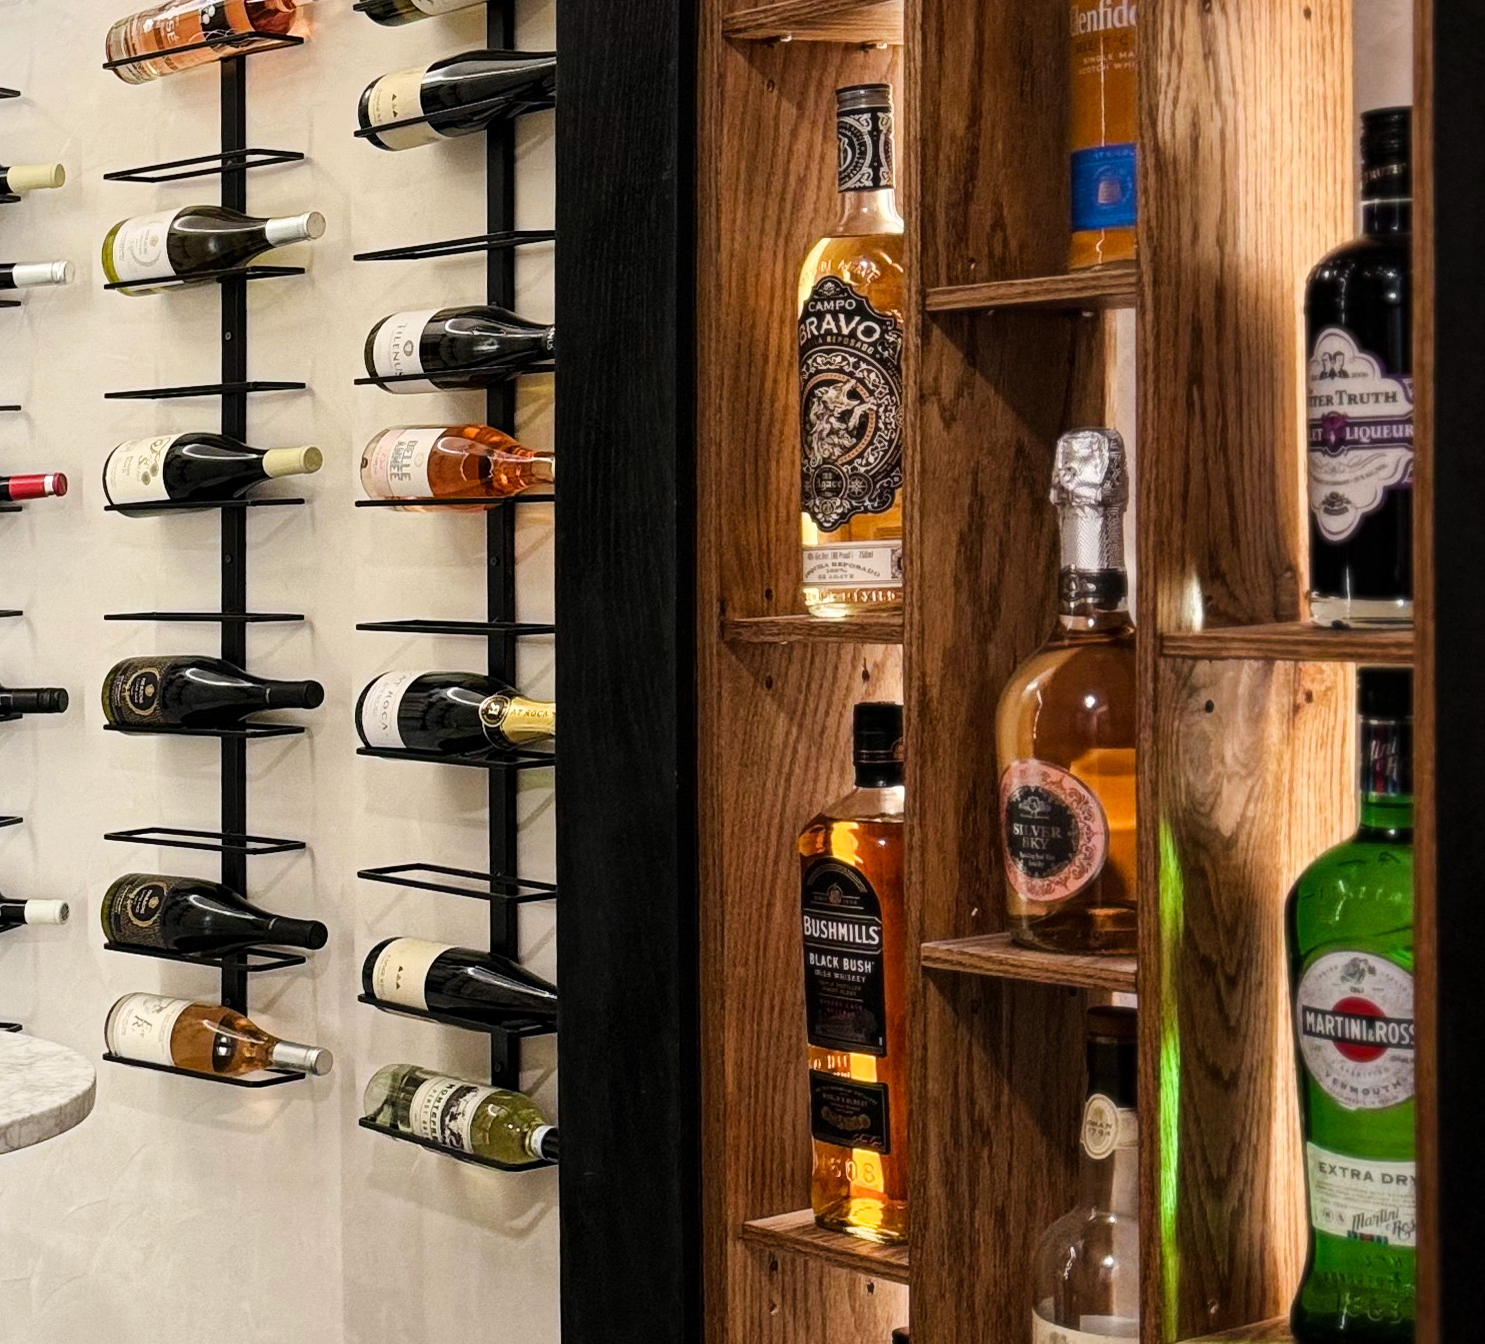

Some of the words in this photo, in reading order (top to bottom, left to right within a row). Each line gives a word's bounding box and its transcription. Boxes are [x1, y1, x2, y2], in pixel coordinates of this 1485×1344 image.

[808, 298, 857, 313] CAMPO
[799, 312, 882, 346] BRAVO
[825, 334, 875, 355] REPOSADO
[1334, 388, 1399, 407] TRUTH
[1343, 421, 1415, 441] LIQUEUR
[1013, 822, 1063, 840] SILVER
[1022, 836, 1050, 851] SKY
[802, 914, 881, 946] BUSHMILLS
[809, 952, 840, 970] BLACK
[842, 956, 873, 975] BUSH
[1325, 1069, 1402, 1096] VERMOUTH
[1318, 1161, 1374, 1183] EXTRA
